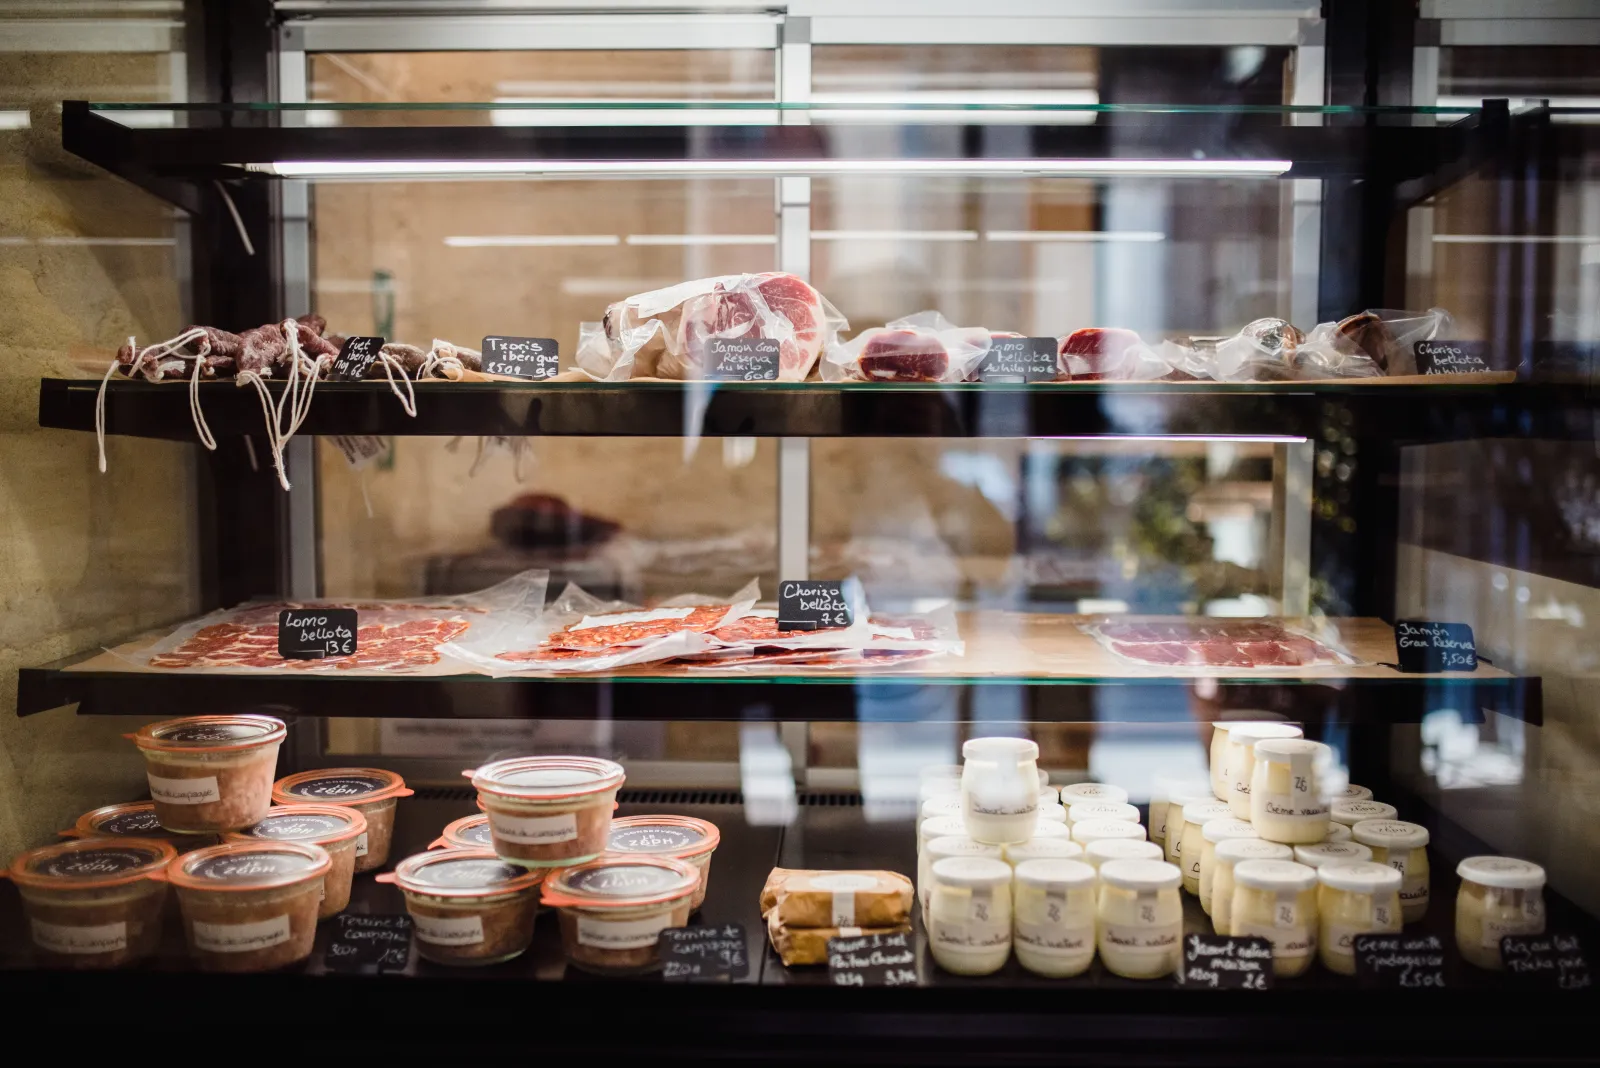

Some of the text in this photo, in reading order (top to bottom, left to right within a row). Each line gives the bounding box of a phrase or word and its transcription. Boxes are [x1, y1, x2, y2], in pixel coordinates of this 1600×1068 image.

[486, 338, 543, 352] Txoris
[755, 342, 779, 353] Gran
[1418, 343, 1462, 358] Chorizo
[502, 350, 559, 367] ibérique
[1433, 354, 1485, 366] bellota
[533, 367, 557, 378] 9€
[744, 369, 775, 381] 60€
[784, 583, 839, 602] Chorizo
[800, 597, 851, 612] bellota
[285, 612, 328, 627] Lomo
[300, 625, 352, 642] bellota
[1400, 637, 1429, 648] Gran
[1441, 651, 1475, 667] 7,50€
